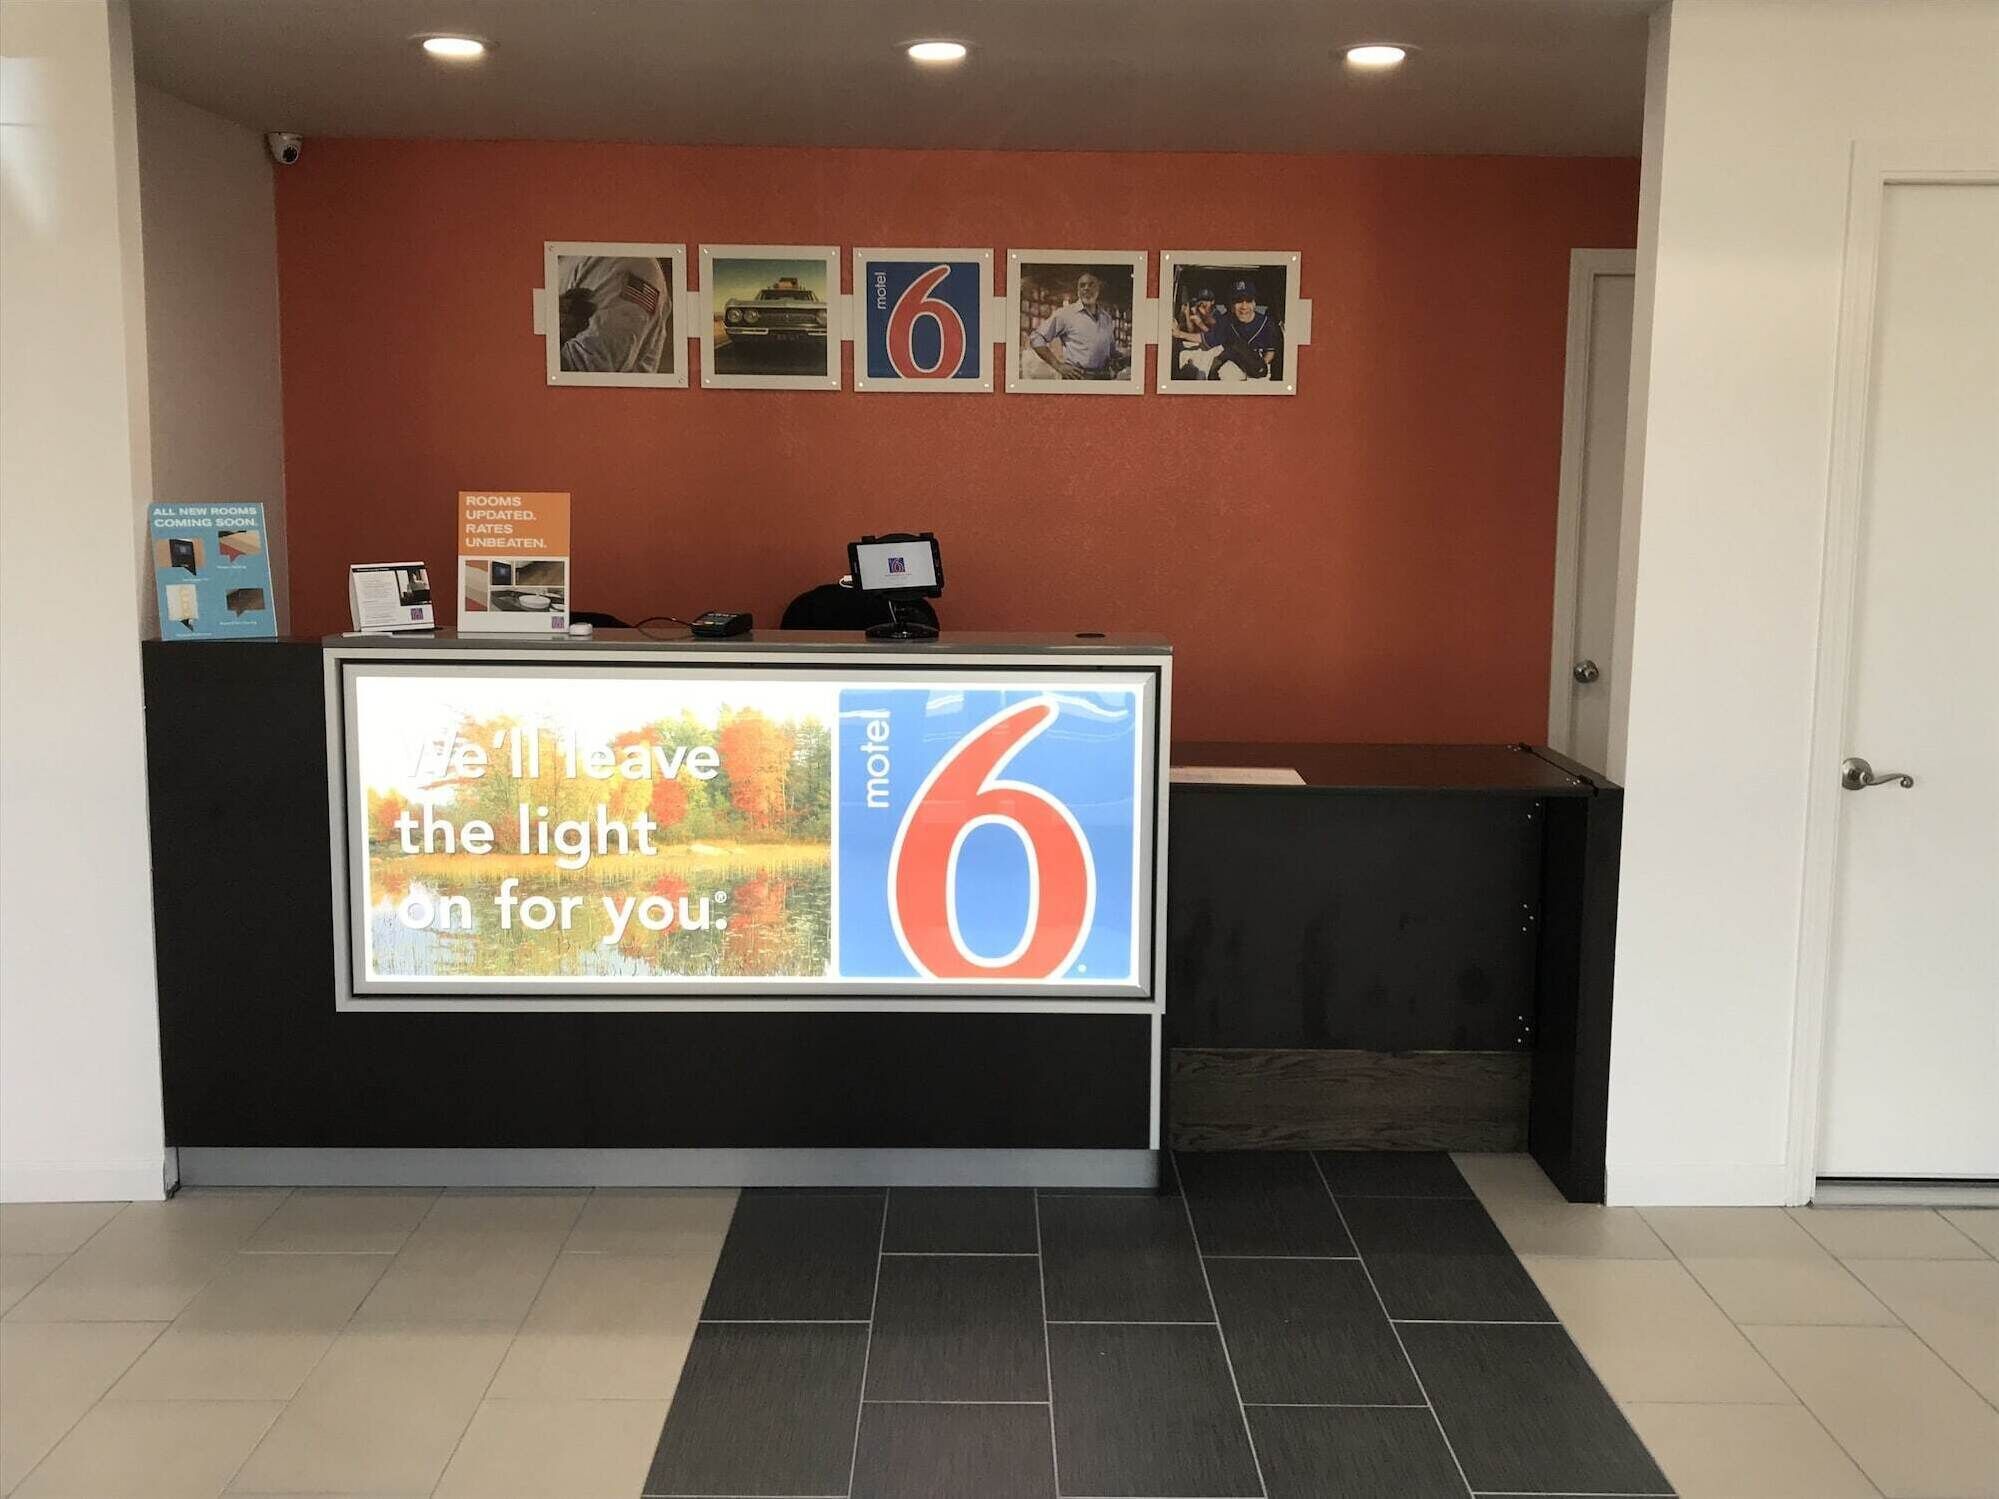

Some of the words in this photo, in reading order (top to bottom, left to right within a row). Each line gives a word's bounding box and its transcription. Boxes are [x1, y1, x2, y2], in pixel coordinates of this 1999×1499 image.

[874, 271, 887, 310] motel
[885, 264, 967, 379] 6
[465, 495, 522, 507] ROOMS
[153, 507, 176, 516] ALL
[179, 507, 207, 516] NEW
[210, 506, 258, 516] ROOMS
[465, 509, 537, 521] UPDATED.
[154, 518, 213, 529] COMING
[215, 517, 259, 528] SOON.
[465, 523, 514, 534] RATES
[465, 537, 548, 549] UNBEATEN.
[565, 726, 721, 781] leave
[394, 803, 495, 856] the
[518, 802, 658, 870] light
[859, 710, 891, 808] motel
[886, 692, 1097, 979] 6
[401, 894, 473, 931] on
[494, 877, 584, 931] for
